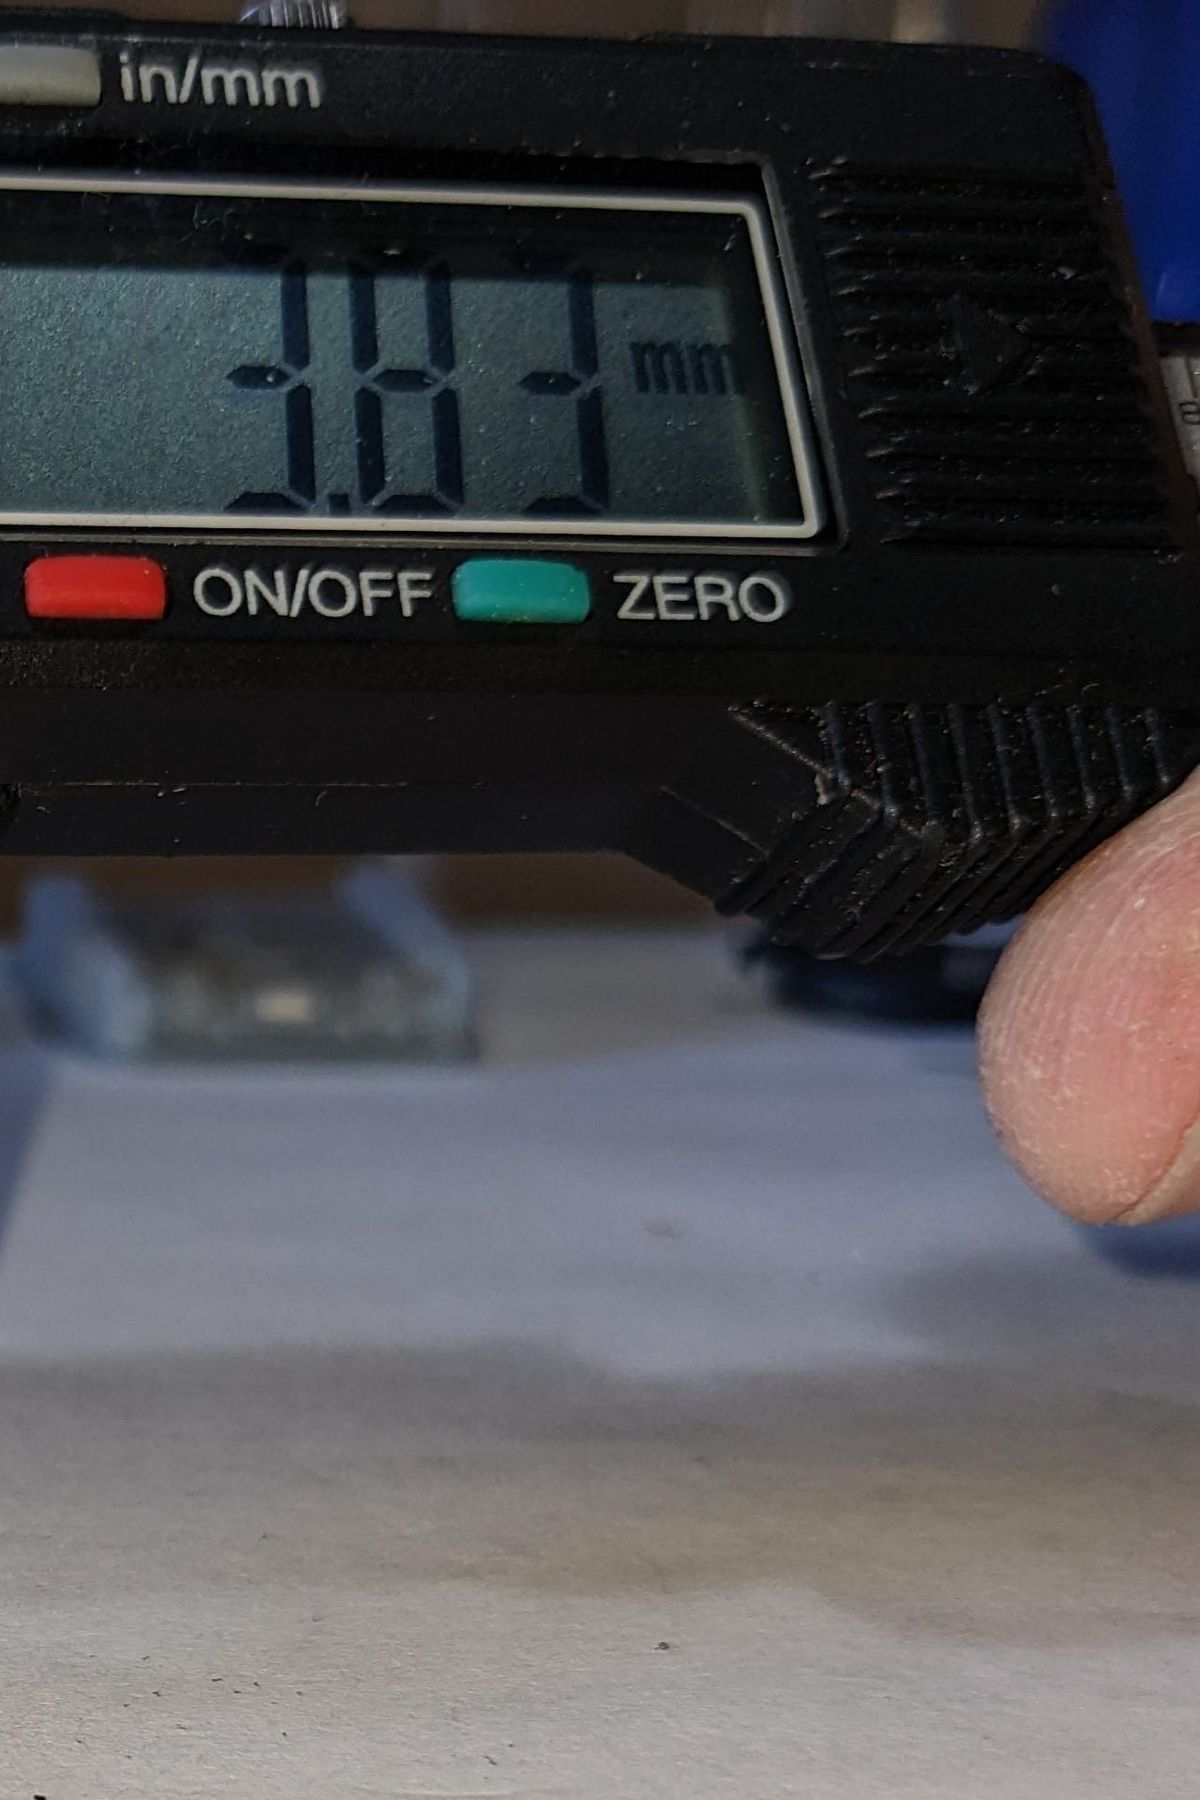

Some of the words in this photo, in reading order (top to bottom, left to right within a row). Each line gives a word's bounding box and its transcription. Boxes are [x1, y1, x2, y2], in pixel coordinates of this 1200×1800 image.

[119, 52, 321, 108] in/mm
[222, 242, 609, 516] 3.83
[629, 341, 747, 394] mm
[193, 568, 434, 618] ON/OFF
[613, 575, 785, 623] ZERO
